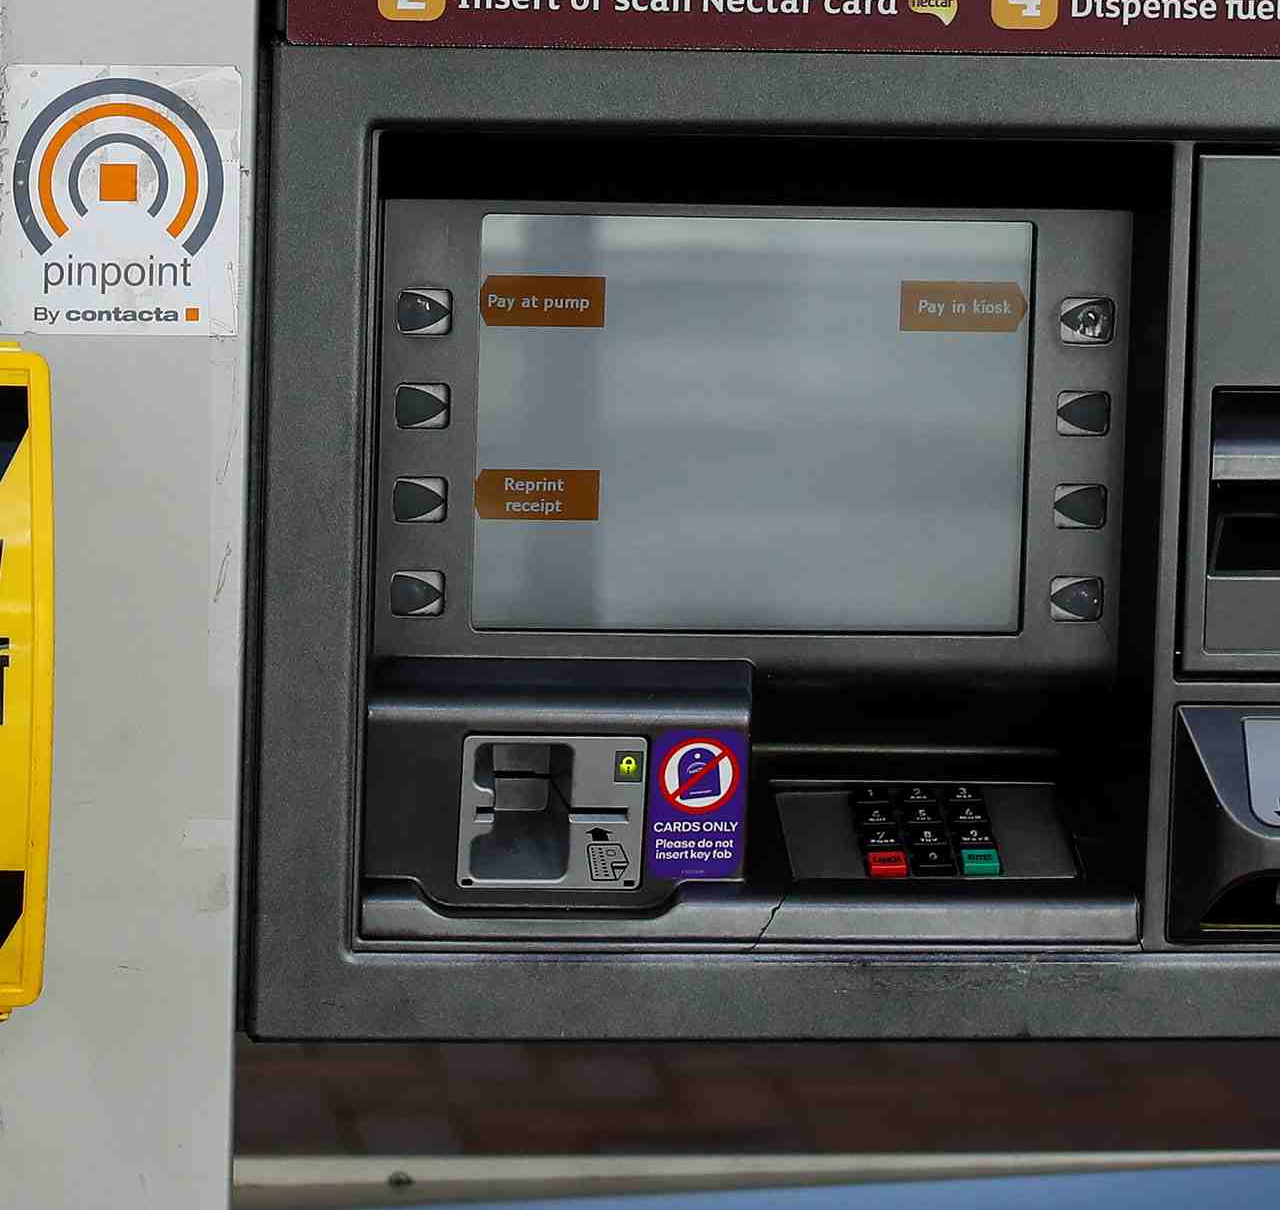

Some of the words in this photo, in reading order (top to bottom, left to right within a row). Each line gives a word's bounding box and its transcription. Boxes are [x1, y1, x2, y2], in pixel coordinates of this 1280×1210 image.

[43, 254, 192, 294] pinpoint
[487, 294, 515, 312] Pay
[521, 294, 538, 310] at
[544, 296, 590, 314] pump
[918, 300, 945, 317] Pay
[952, 300, 966, 315] in
[972, 299, 1013, 316] kiosk
[34, 307, 60, 324] By
[65, 306, 179, 322] contacta
[504, 477, 565, 495] Reprint
[505, 497, 562, 515] receipt
[654, 822, 700, 832] CARDS
[703, 821, 738, 832] ONLY
[656, 839, 696, 849] Please
[697, 839, 713, 849] do
[715, 839, 734, 849] not
[656, 850, 689, 860] insert
[690, 850, 710, 861] key
[713, 849, 732, 859] fob
